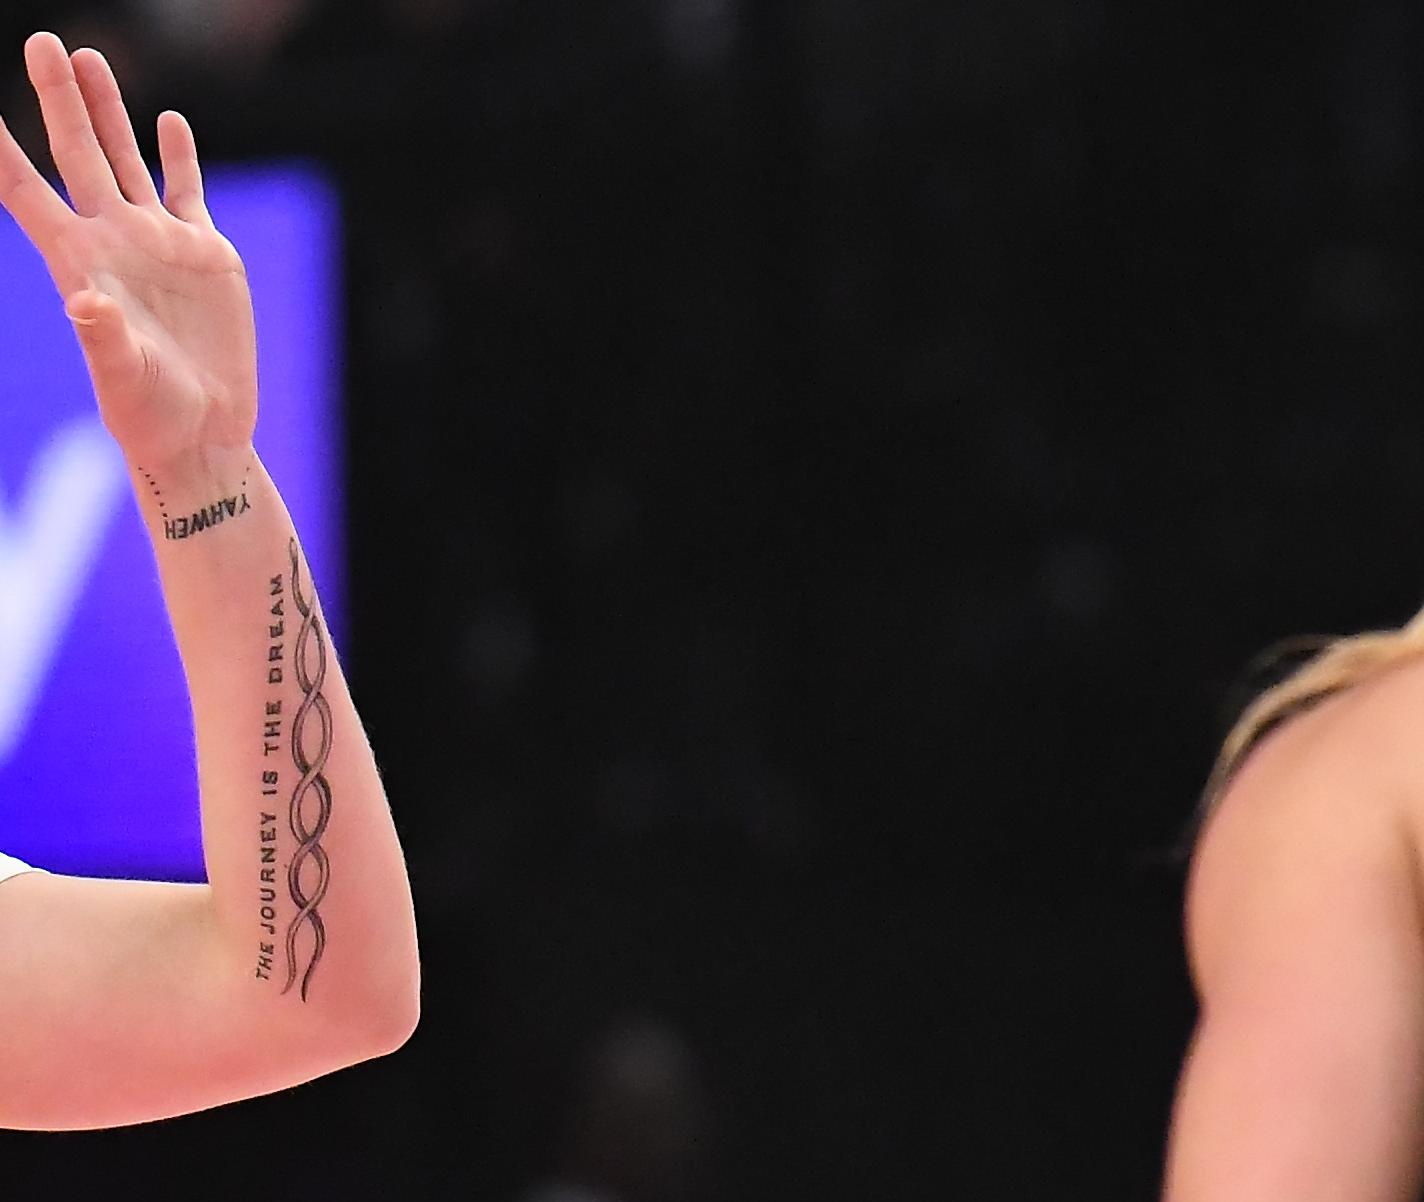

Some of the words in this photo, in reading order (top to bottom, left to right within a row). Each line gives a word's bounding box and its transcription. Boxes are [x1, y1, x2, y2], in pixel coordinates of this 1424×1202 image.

[164, 493, 251, 540] YAHWEH
[268, 573, 284, 685] DREAM
[264, 701, 282, 757] THE
[263, 770, 279, 796] IS
[260, 812, 277, 936] JOURNEY
[256, 942, 274, 980] THE
